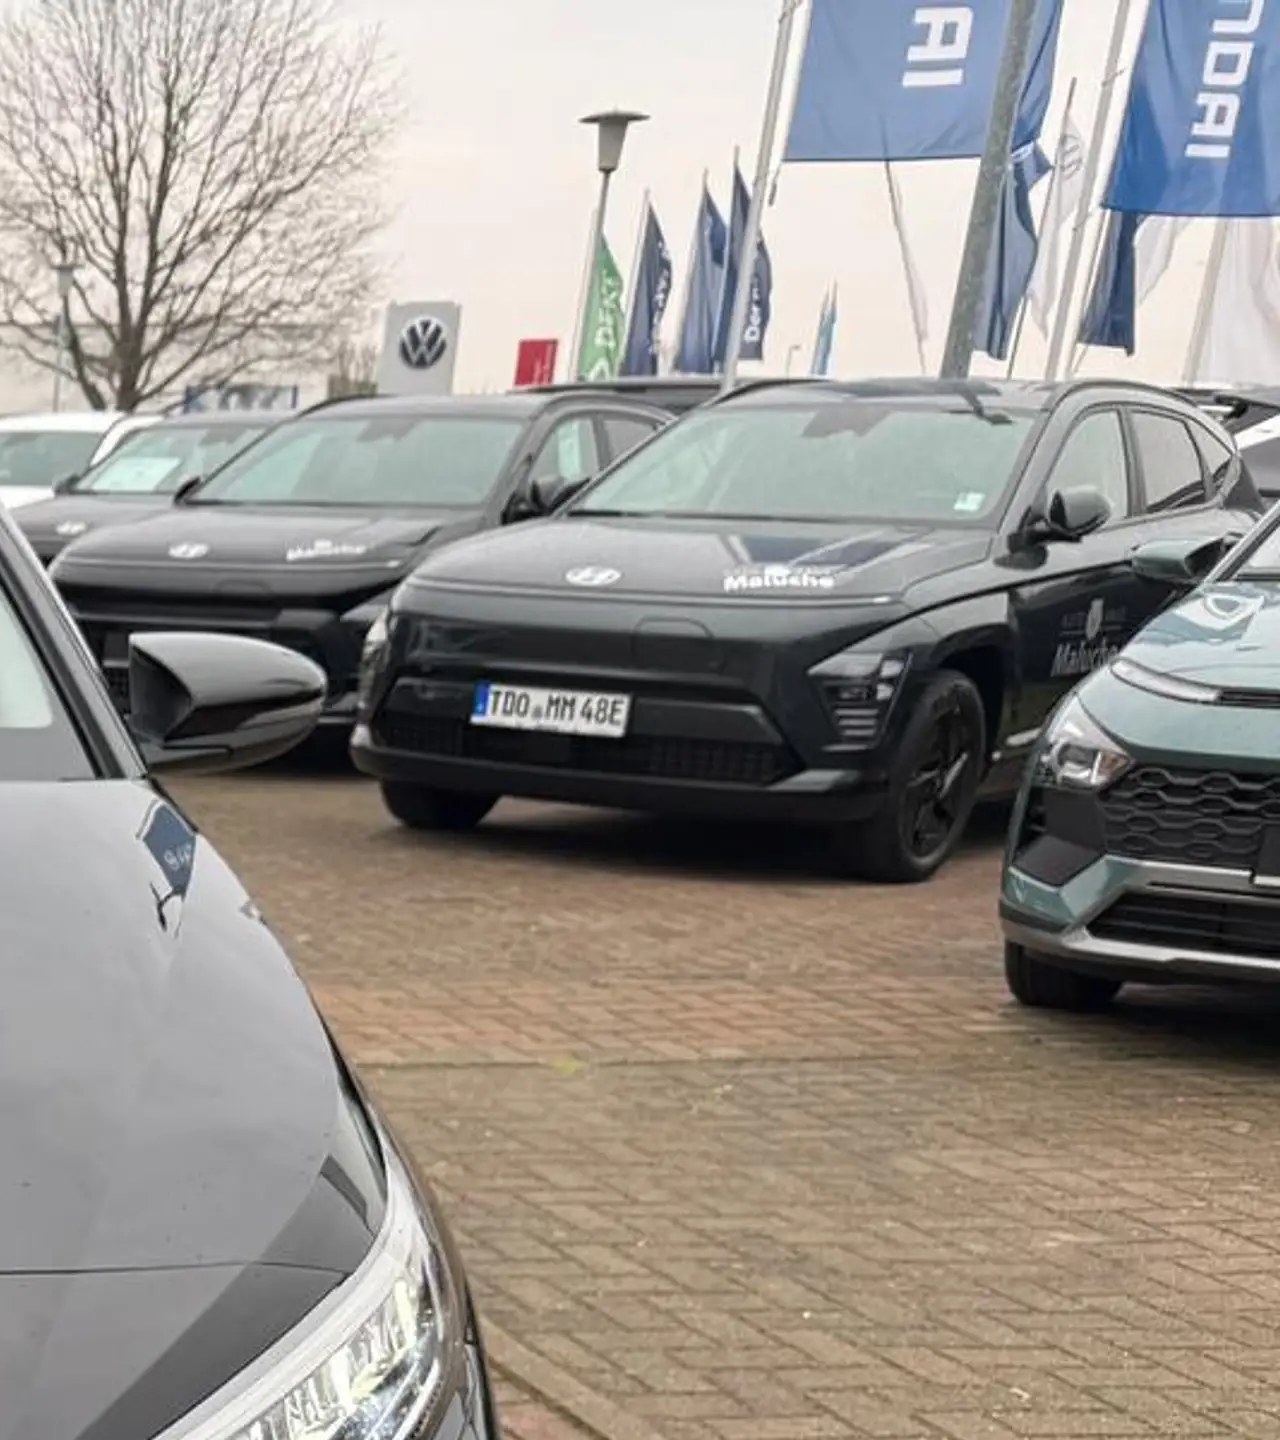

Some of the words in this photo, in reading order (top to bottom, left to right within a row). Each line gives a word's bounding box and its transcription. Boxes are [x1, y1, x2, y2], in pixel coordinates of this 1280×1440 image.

[491, 690, 530, 717] TDO
[546, 694, 575, 721] MM
[580, 699, 624, 726] 48E
